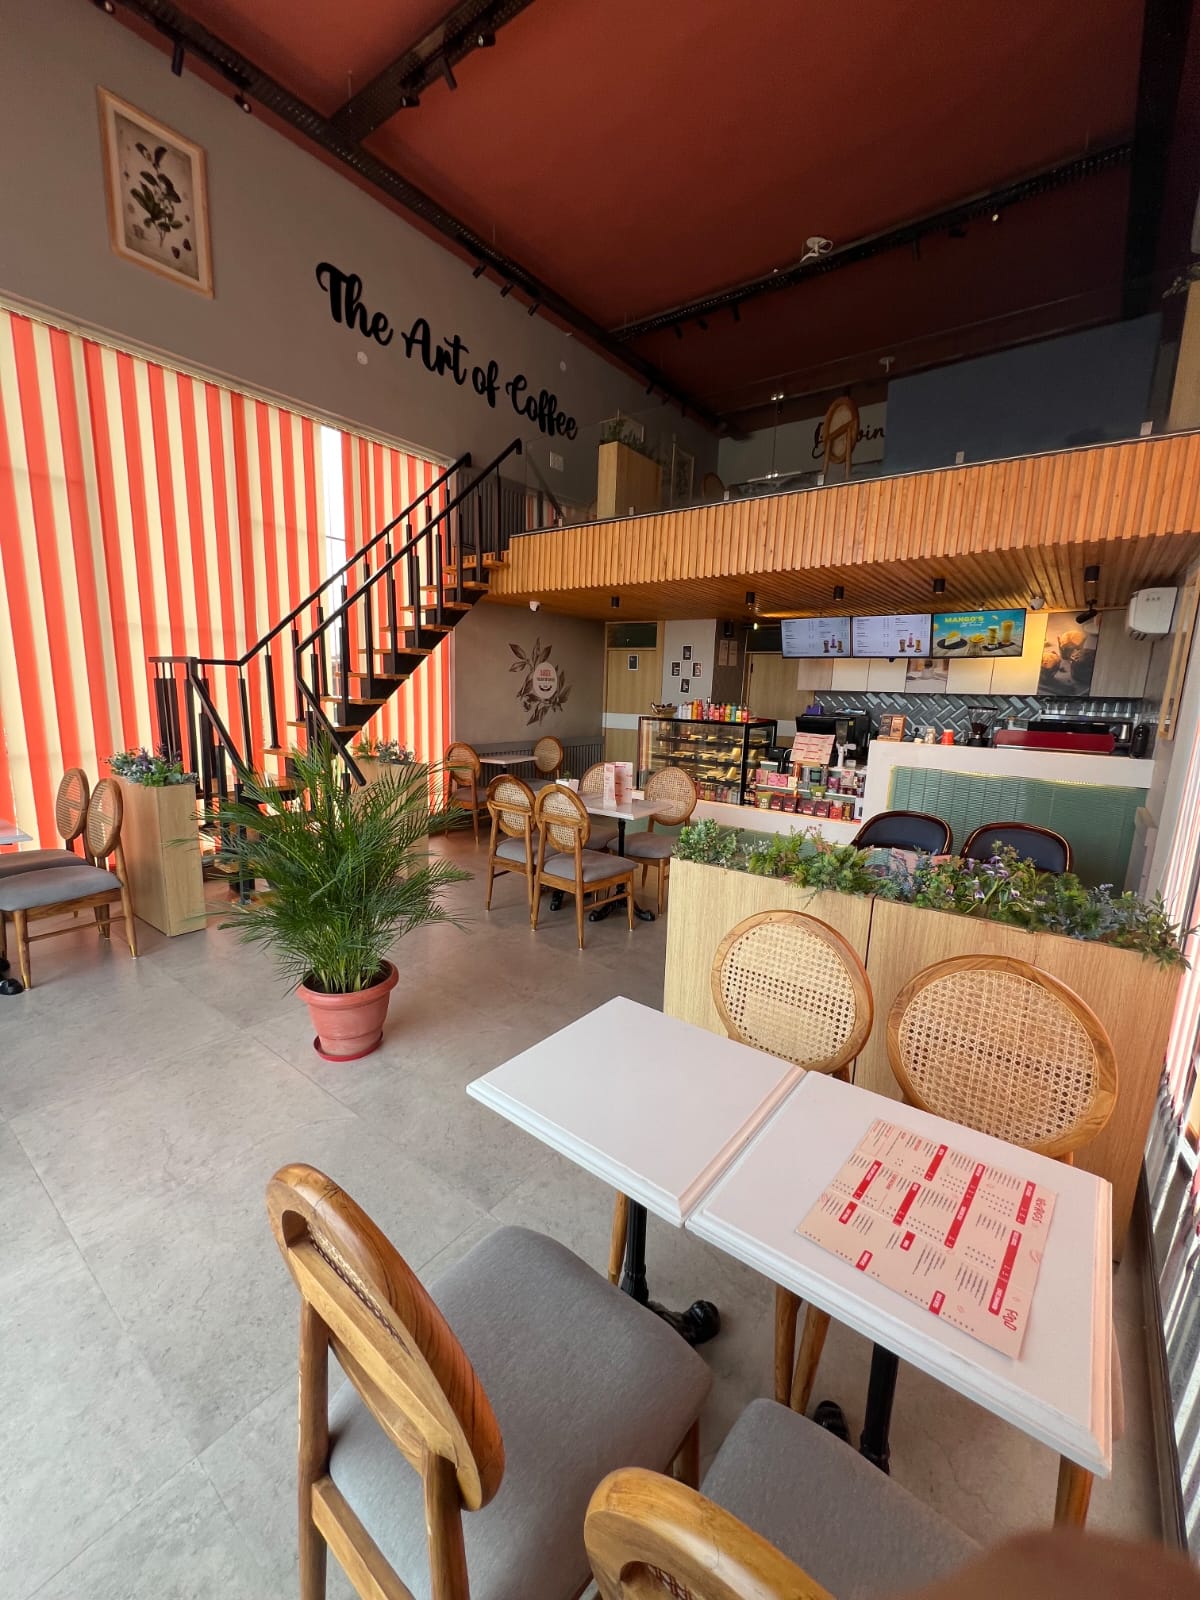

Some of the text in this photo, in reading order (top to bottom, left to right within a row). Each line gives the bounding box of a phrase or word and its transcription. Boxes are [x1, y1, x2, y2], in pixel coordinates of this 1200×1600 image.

[315, 262, 578, 440] The Art of Coffee
[944, 615, 984, 623] MANGO'S
